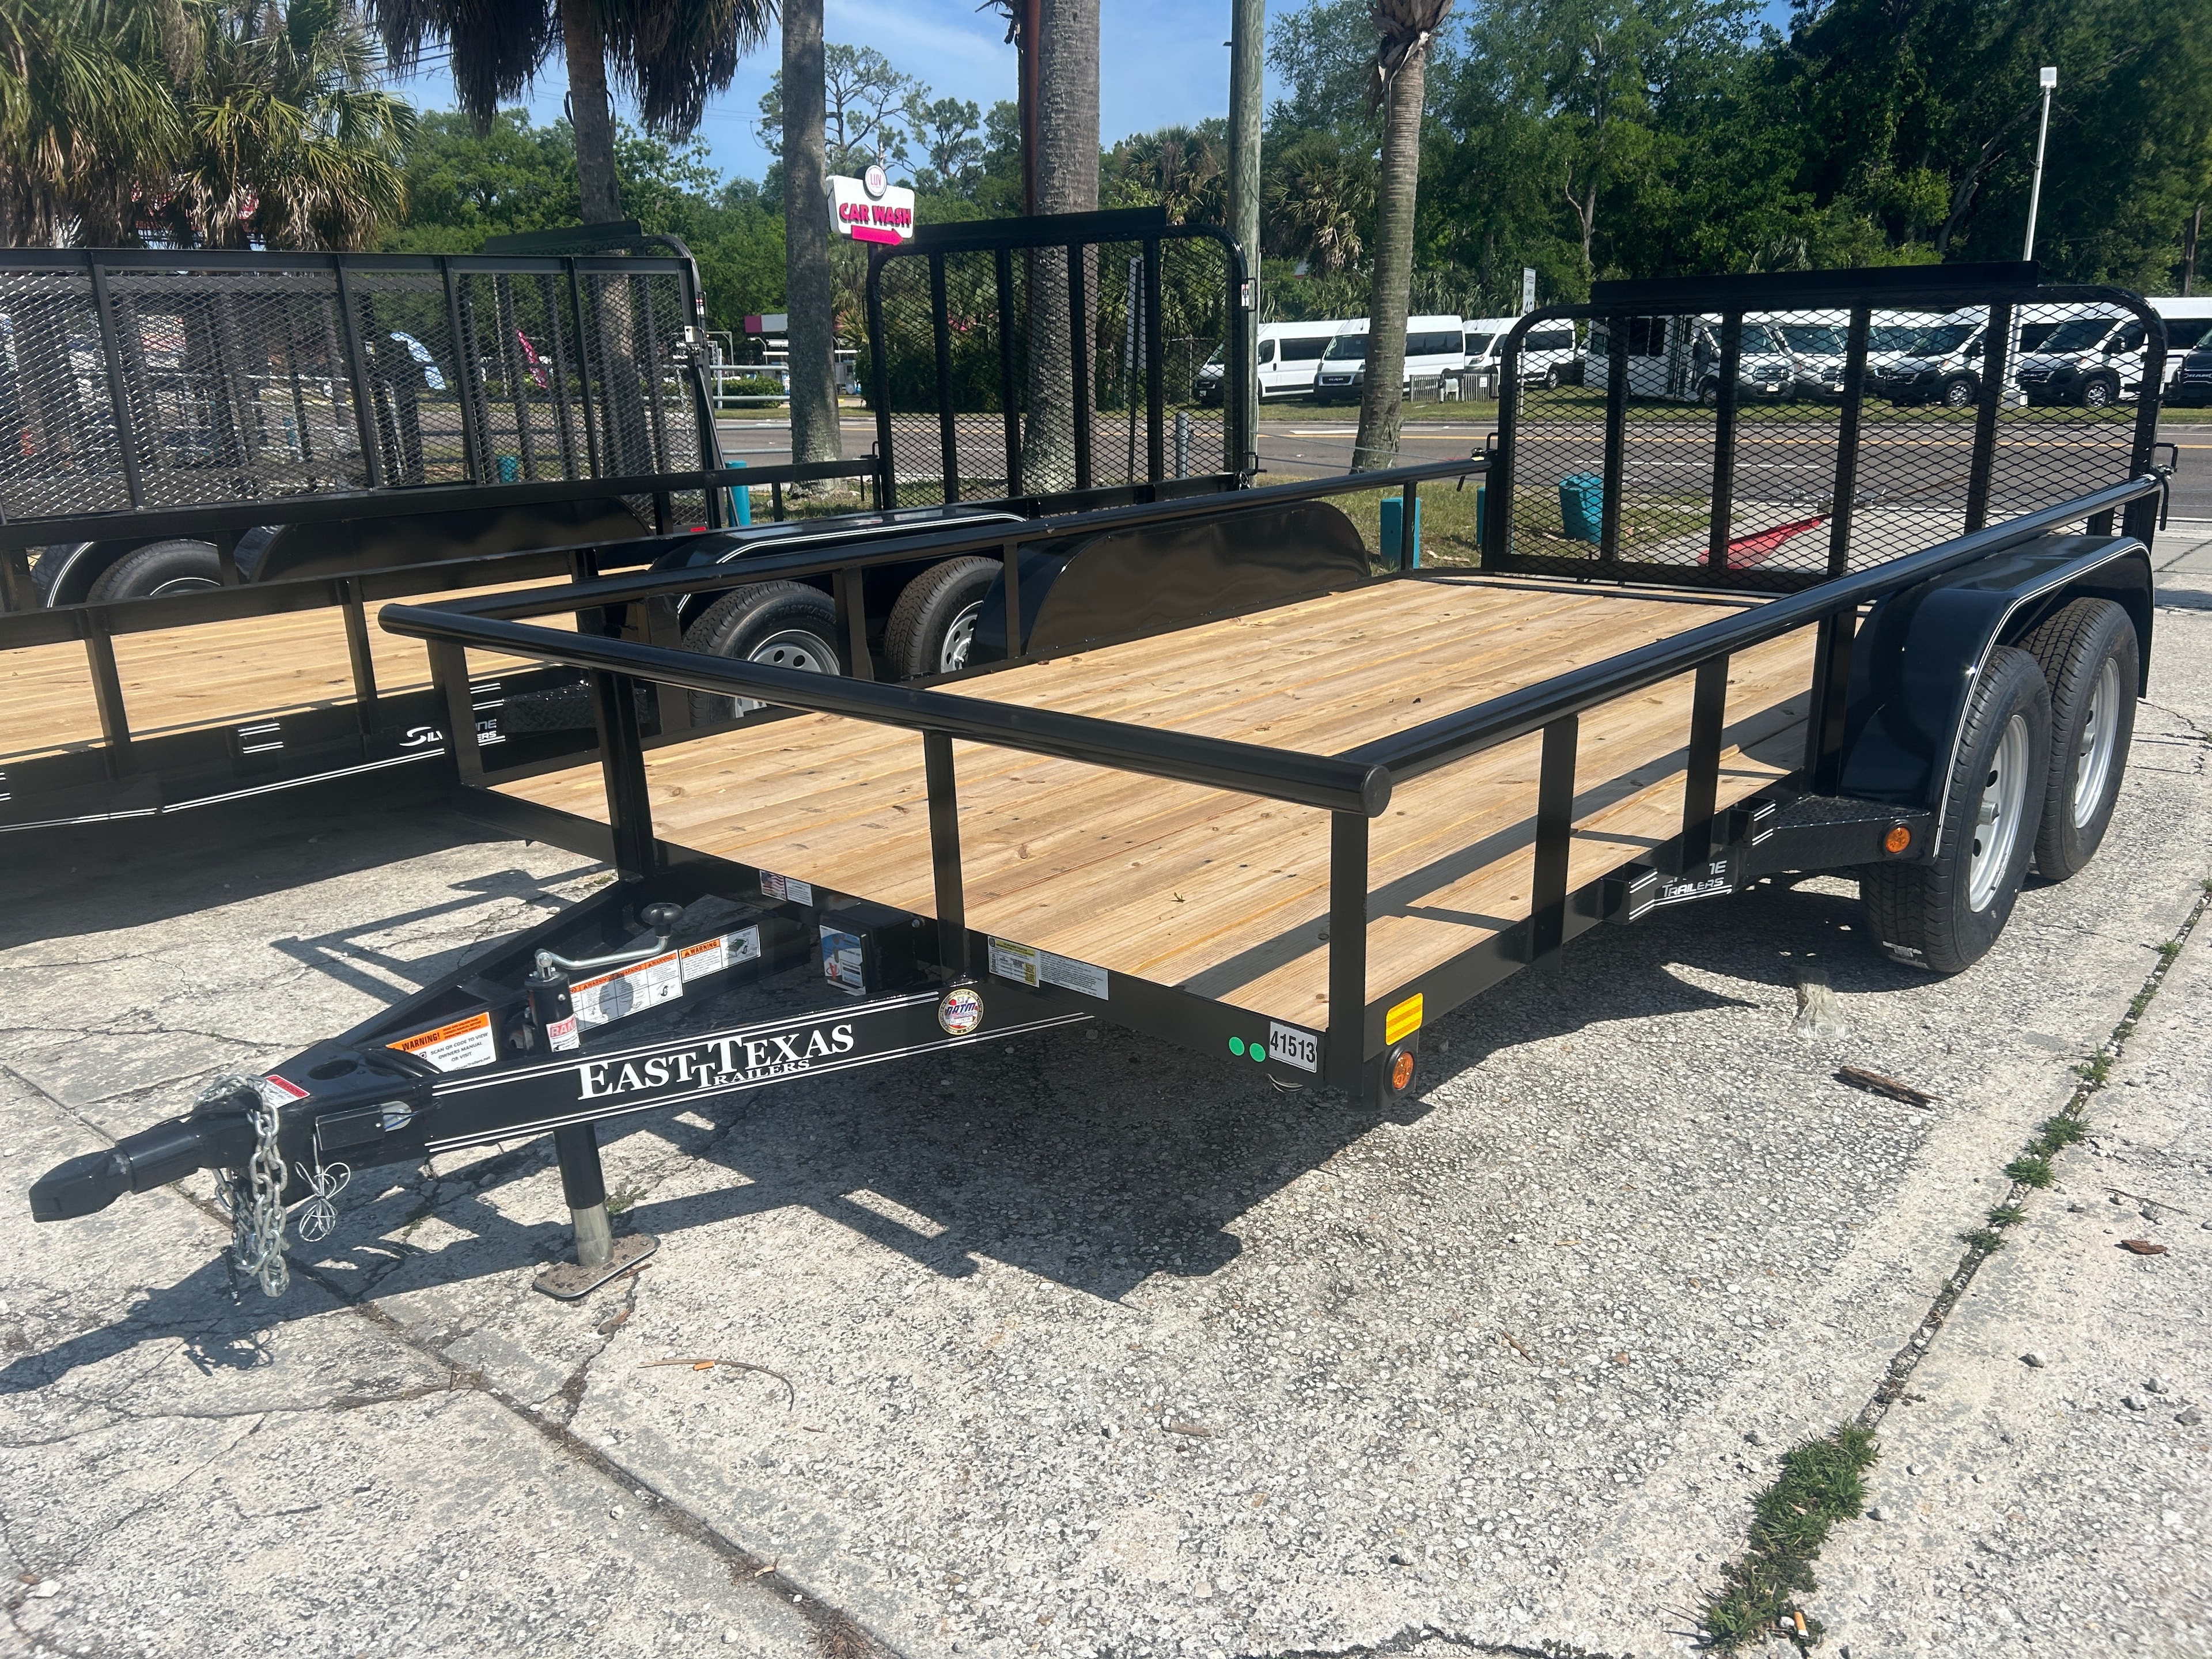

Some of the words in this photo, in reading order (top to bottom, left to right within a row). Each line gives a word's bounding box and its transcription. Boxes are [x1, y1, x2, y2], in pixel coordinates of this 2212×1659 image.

[839, 203, 870, 225] CAR
[872, 205, 911, 228] WASH
[1662, 877, 1725, 897] TRAILERS
[691, 941, 717, 955] WARNING
[652, 955, 673, 966] WARNING
[588, 976, 611, 988] WARNING
[402, 1032, 440, 1051] WARNING!
[438, 1049, 460, 1059] OWNERS
[461, 1041, 483, 1051] MANUAL
[1270, 1031, 1315, 1063] 41513
[578, 1051, 698, 1100] EAST
[708, 1024, 855, 1075] TEXAS
[691, 1060, 810, 1089] TRAILERS
